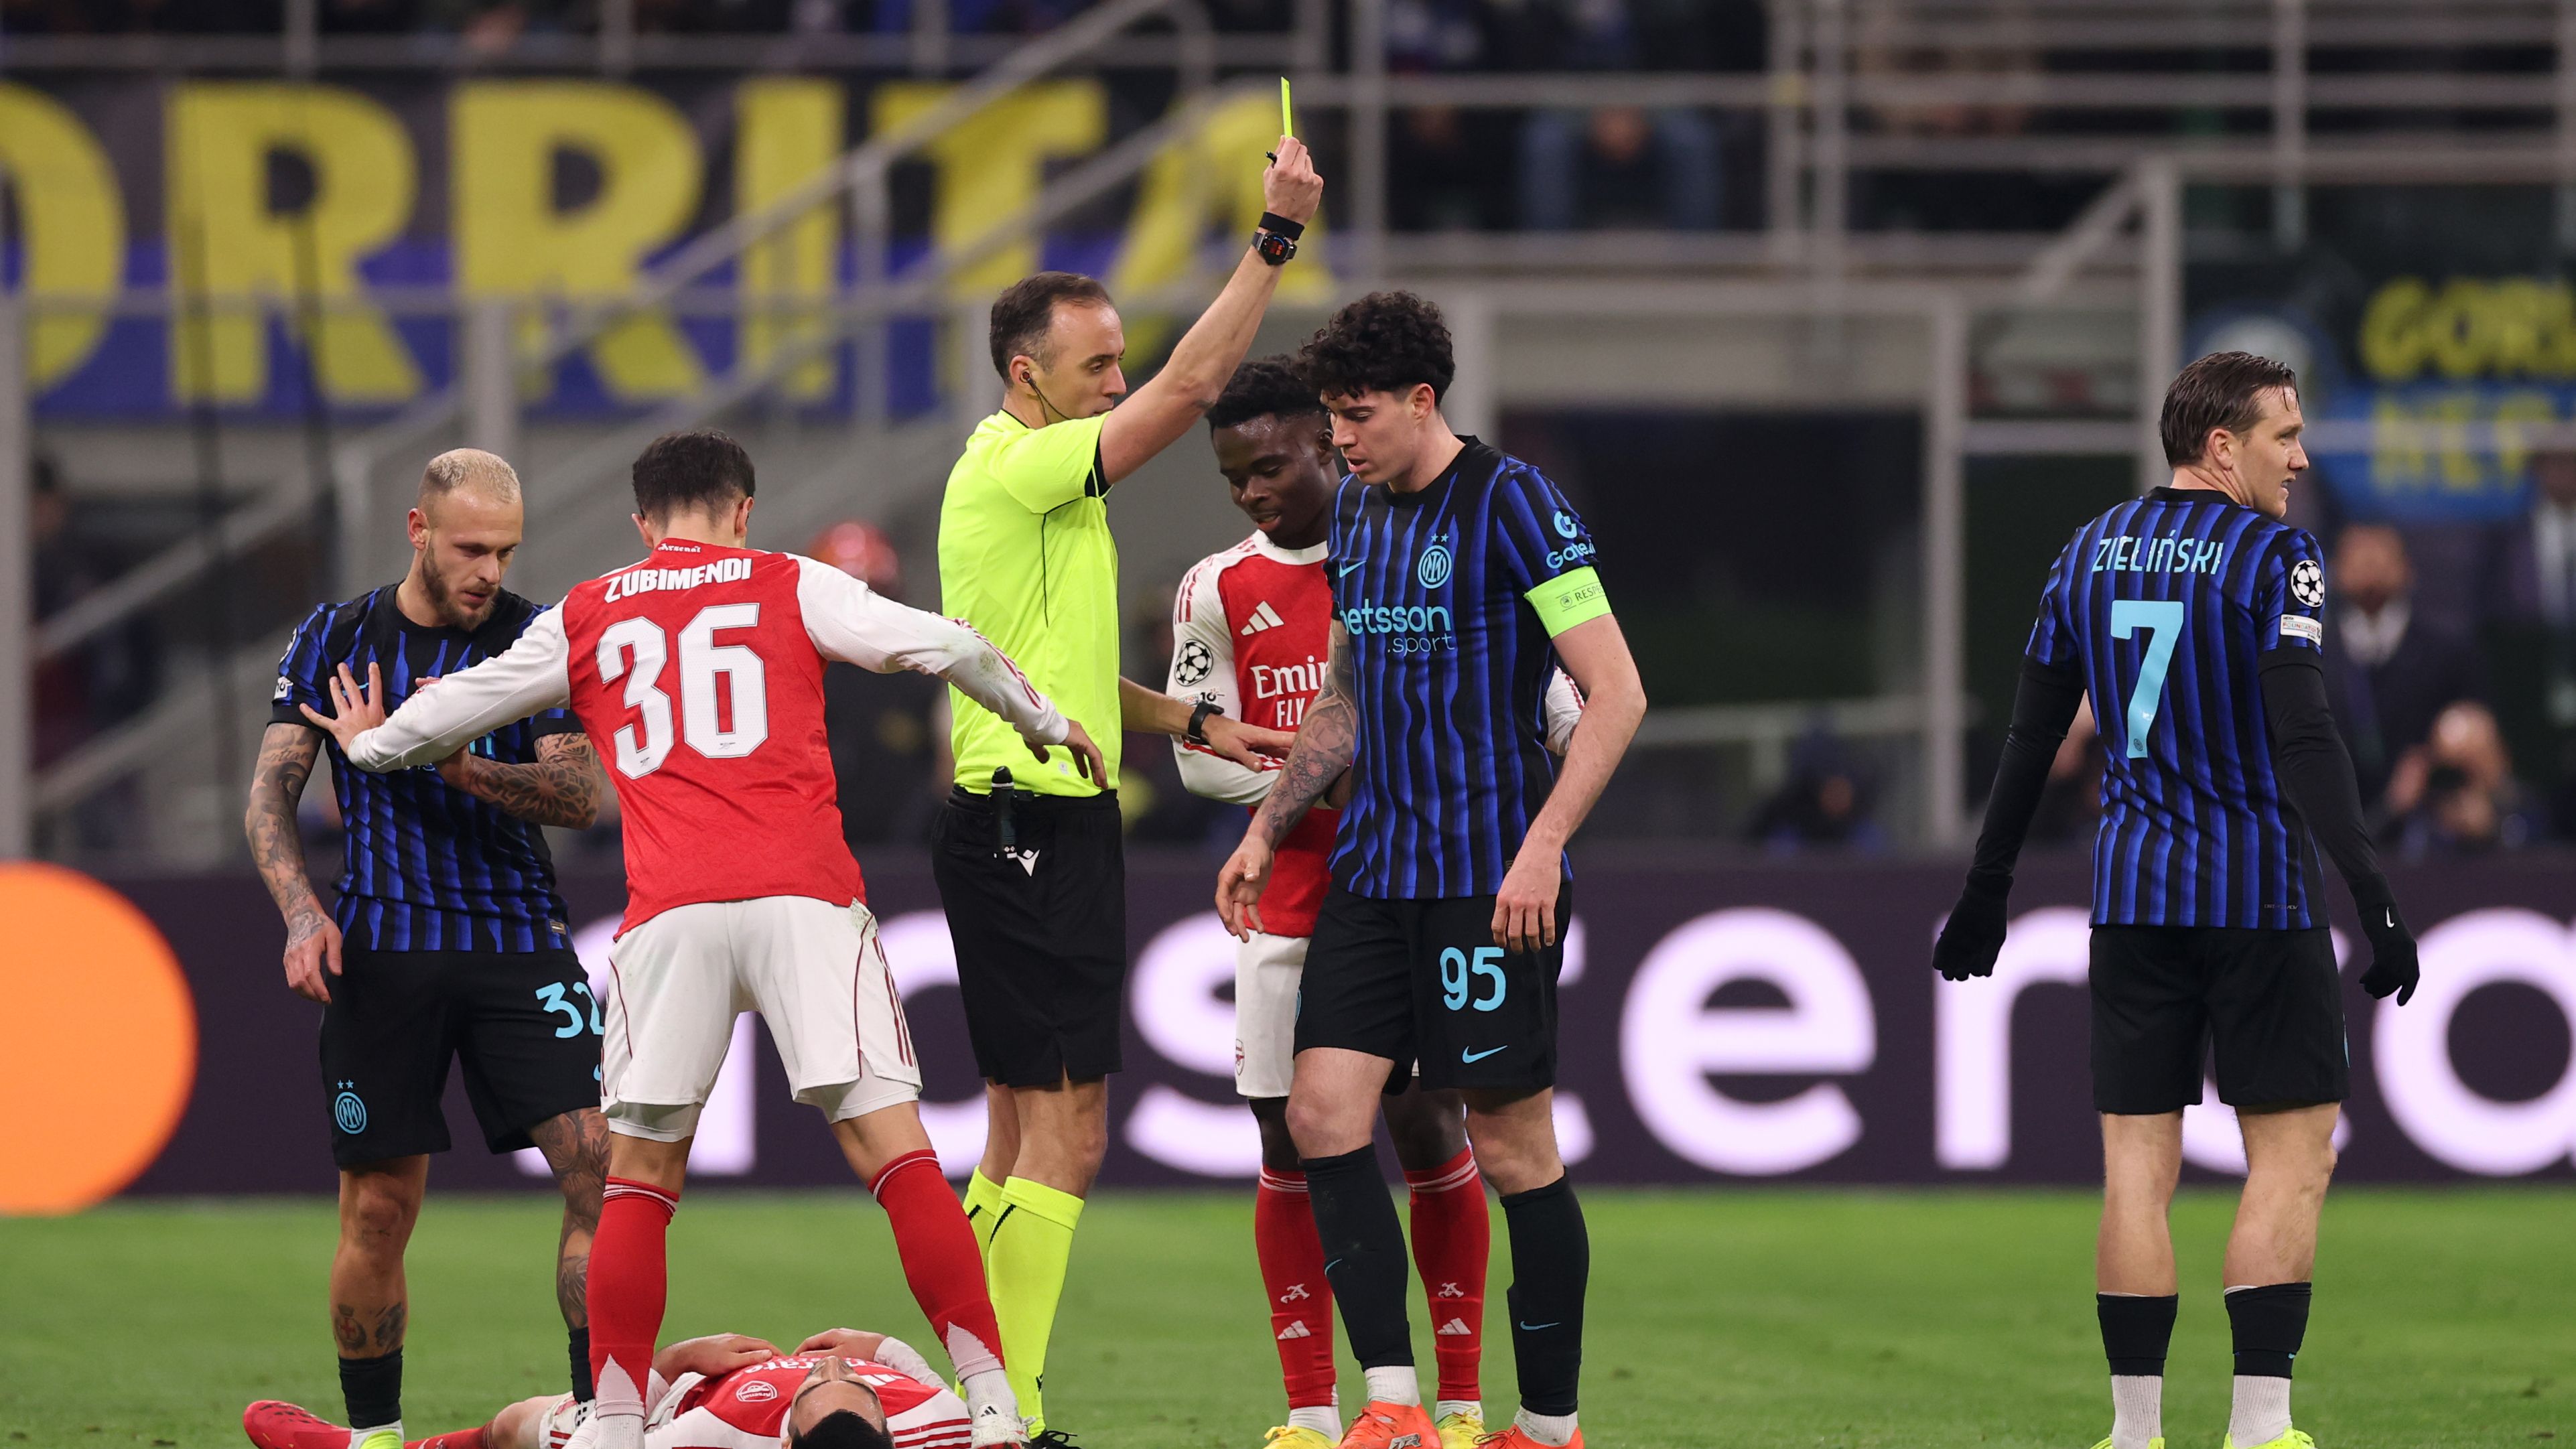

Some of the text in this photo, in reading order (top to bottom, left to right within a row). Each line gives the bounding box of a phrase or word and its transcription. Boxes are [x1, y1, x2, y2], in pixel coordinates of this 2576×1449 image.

[657, 543, 701, 553] Arsenal
[2090, 530, 2224, 575] ZIELIŃSKI
[604, 557, 752, 603] ZUBIMENDI
[1387, 633, 1455, 657] .sport
[595, 602, 768, 779] 36
[2110, 600, 2184, 759] 7
[1276, 697, 1306, 728] FLY
[1440, 947, 1507, 1012] 95
